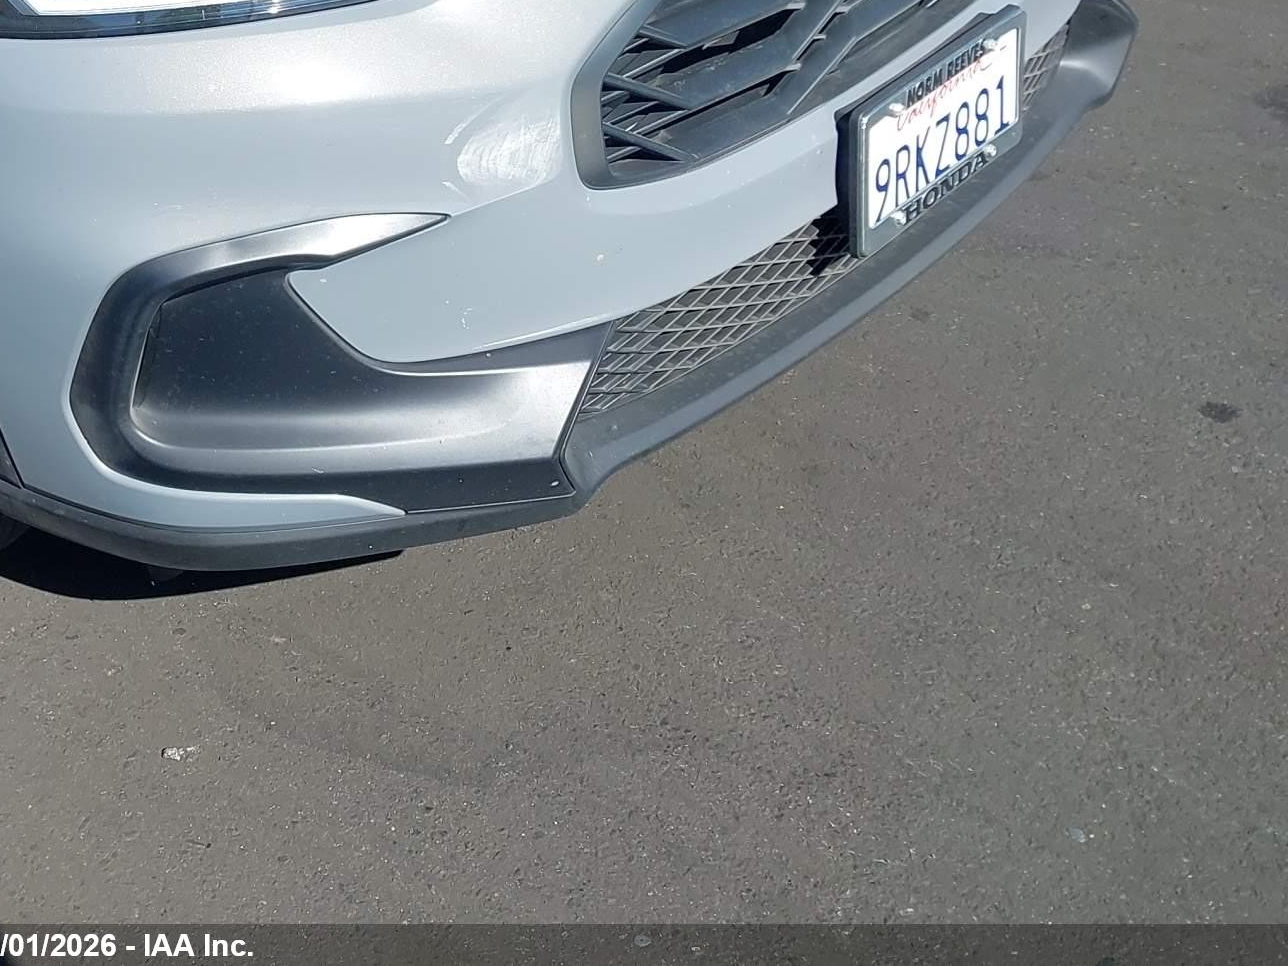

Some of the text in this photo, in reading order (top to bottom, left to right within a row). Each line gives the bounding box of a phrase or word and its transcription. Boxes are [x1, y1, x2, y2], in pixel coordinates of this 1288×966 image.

[905, 39, 985, 109] NORM REEVES
[875, 75, 1010, 223] 9RKZ881
[903, 150, 988, 224] HONDA
